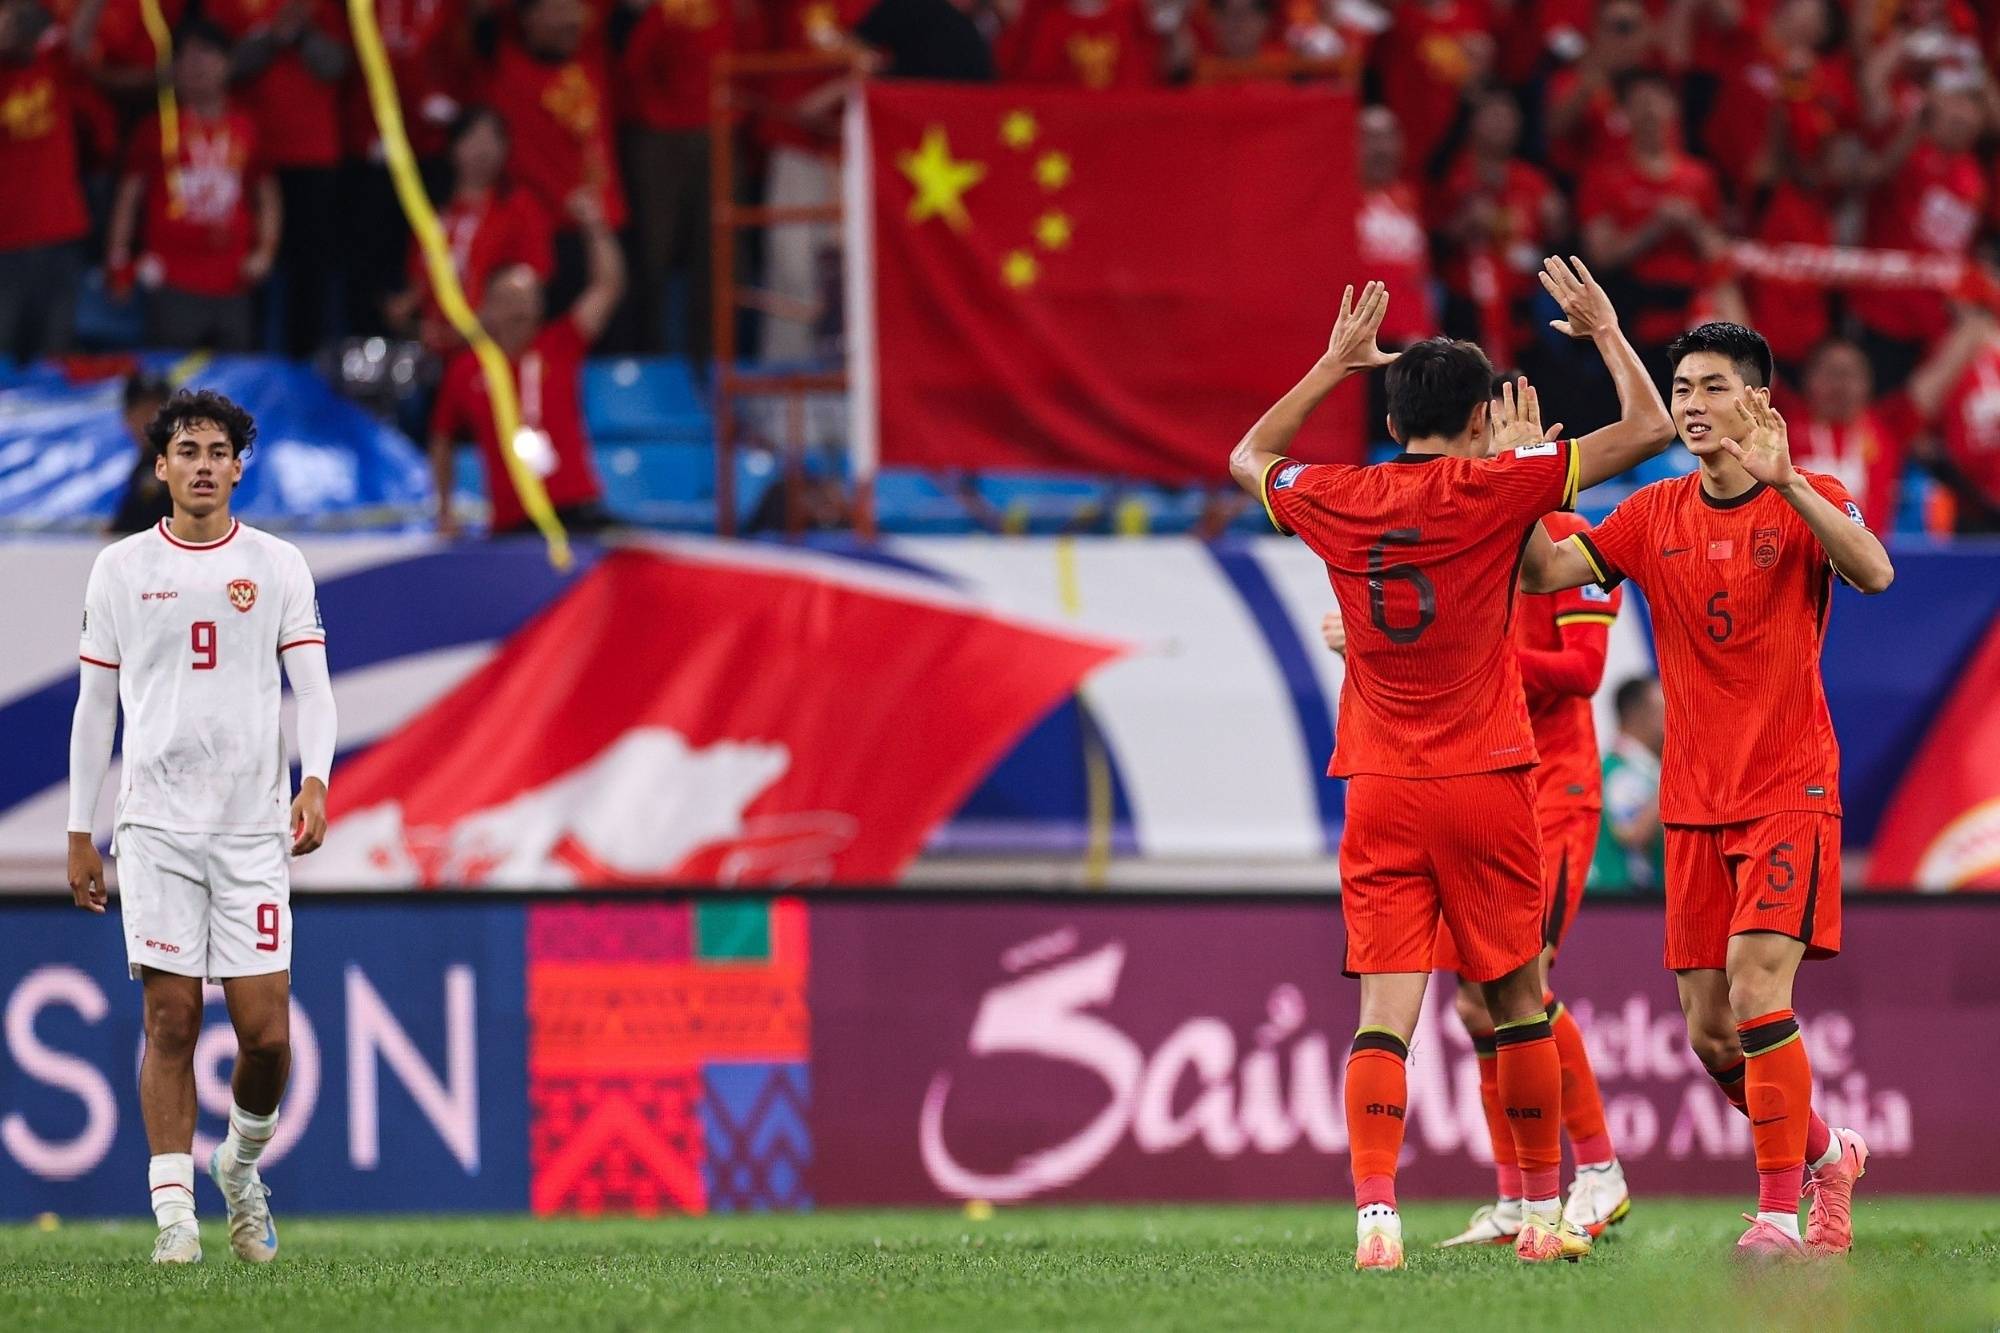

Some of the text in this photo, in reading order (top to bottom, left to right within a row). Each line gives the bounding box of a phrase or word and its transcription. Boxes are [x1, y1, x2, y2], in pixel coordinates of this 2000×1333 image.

[142, 590, 178, 601] erspo
[1367, 527, 1435, 645] 6
[1707, 591, 1732, 643] 5
[191, 621, 217, 670] 9
[1767, 842, 1794, 892] 5
[145, 938, 181, 954] erspo
[256, 903, 279, 952] 9
[1366, 1103, 1404, 1121] 中国
[1505, 1107, 1542, 1120] 中国
